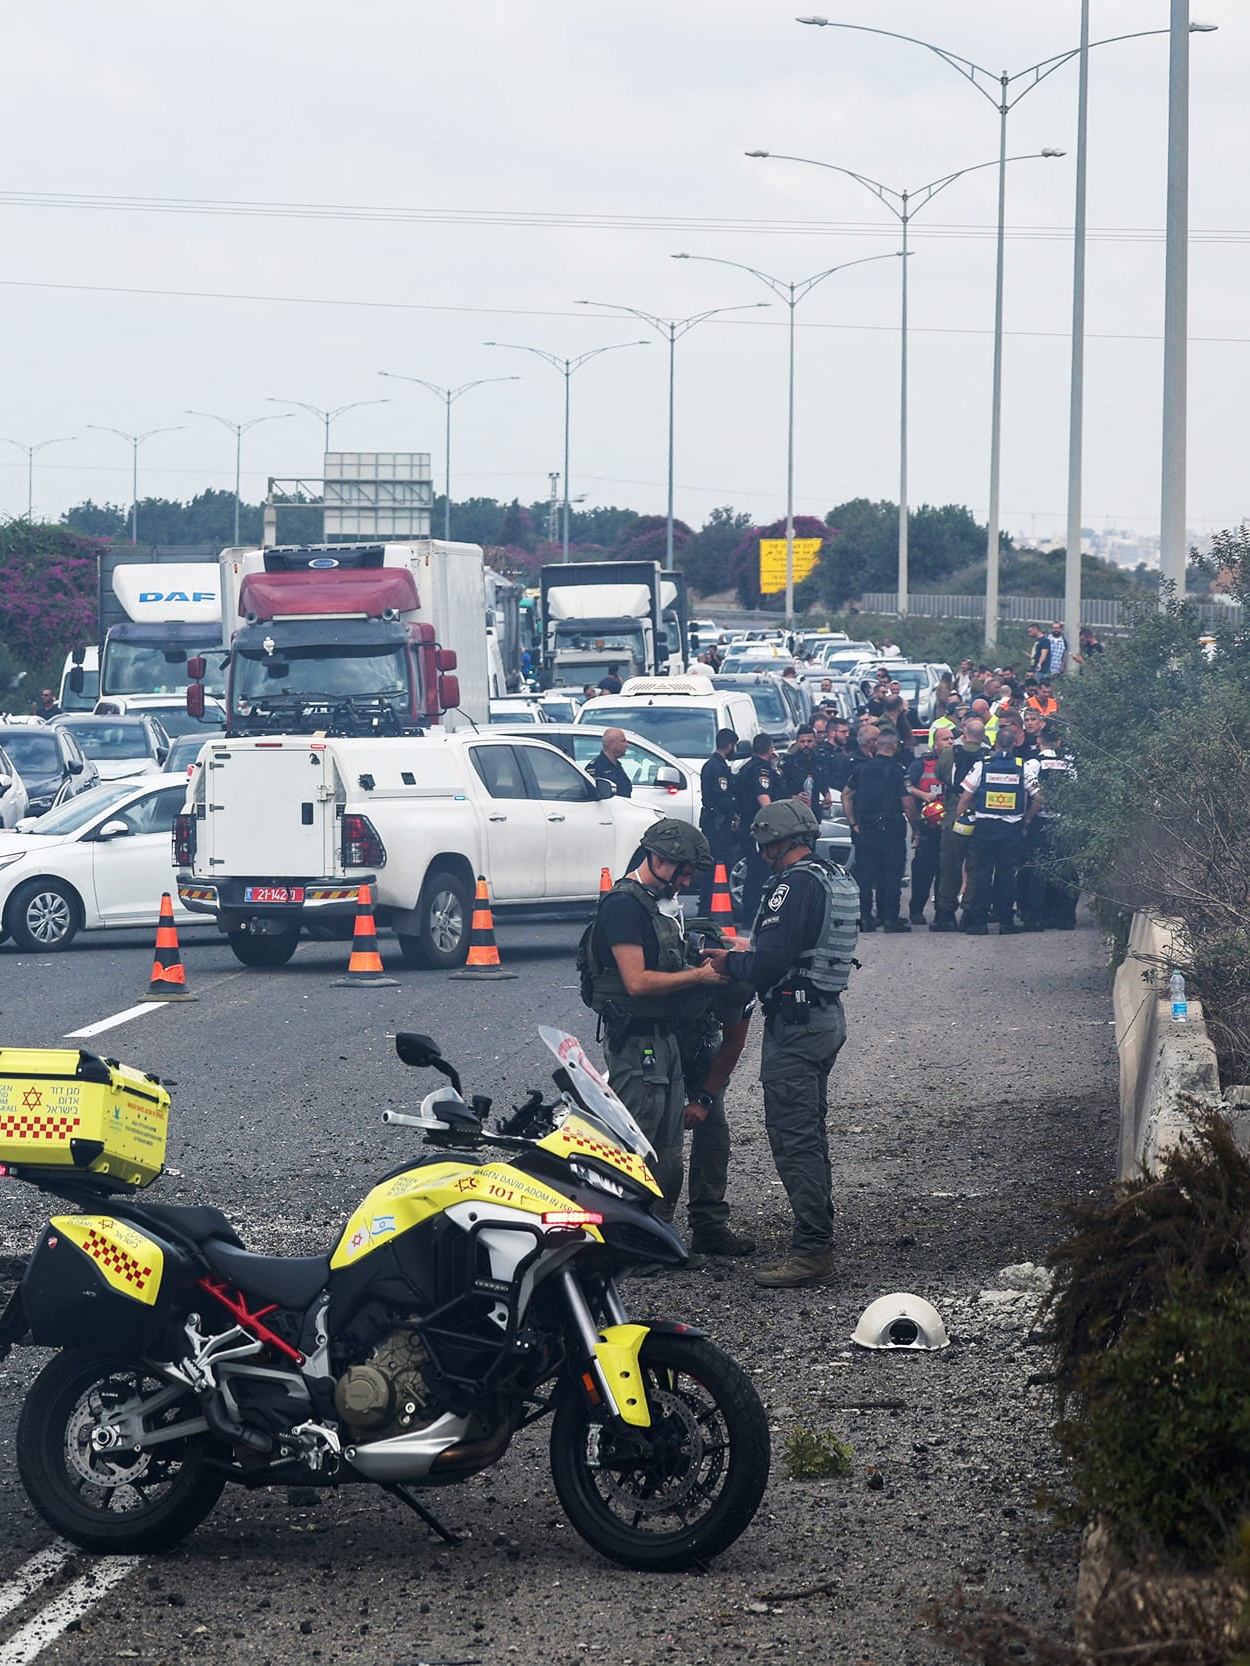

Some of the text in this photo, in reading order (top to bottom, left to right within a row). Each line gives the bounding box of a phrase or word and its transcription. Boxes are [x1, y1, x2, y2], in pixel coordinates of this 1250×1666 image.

[138, 591, 216, 603] DAF
[50, 1086, 81, 1097] מגן דוד
[58, 1096, 80, 1105] אדום
[46, 1104, 79, 1115] בישראל
[473, 1169, 500, 1180] MAGEN
[500, 1175, 525, 1190] DAVID
[524, 1186, 550, 1201] ADOM
[549, 1196, 560, 1207] IN
[488, 1184, 514, 1201] 101
